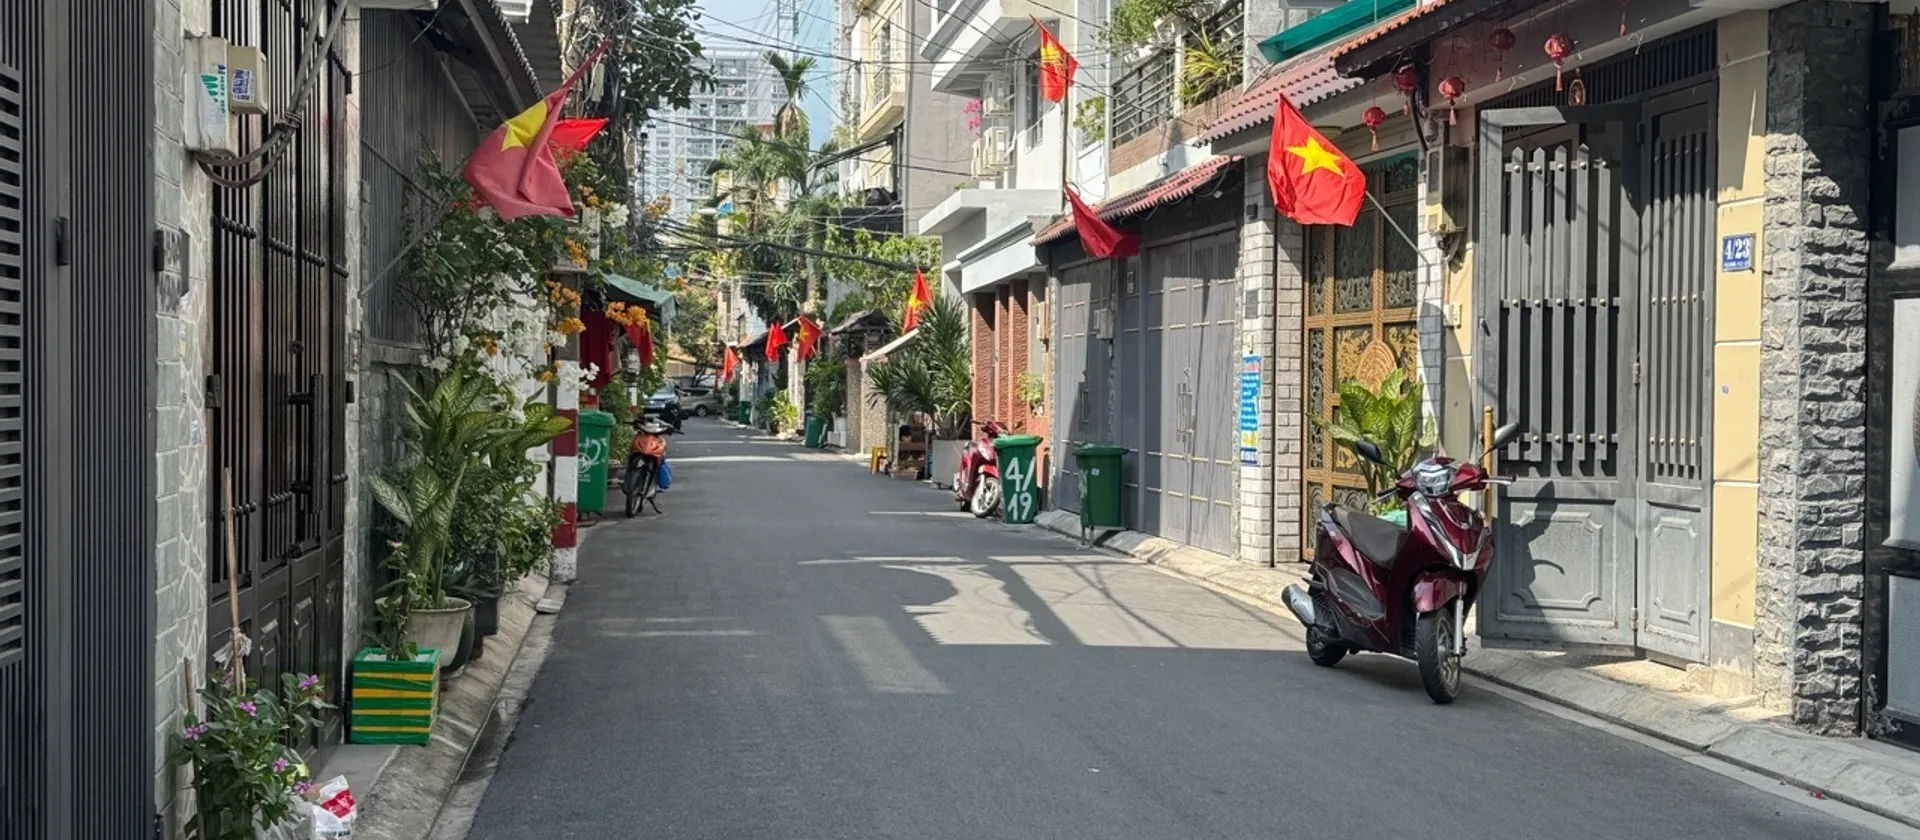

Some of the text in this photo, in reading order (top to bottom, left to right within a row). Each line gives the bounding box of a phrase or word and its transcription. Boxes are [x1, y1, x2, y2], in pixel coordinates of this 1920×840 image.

[1724, 238, 1749, 260] 4/23
[1005, 456, 1036, 492] 4/
[1007, 491, 1032, 521] 19
